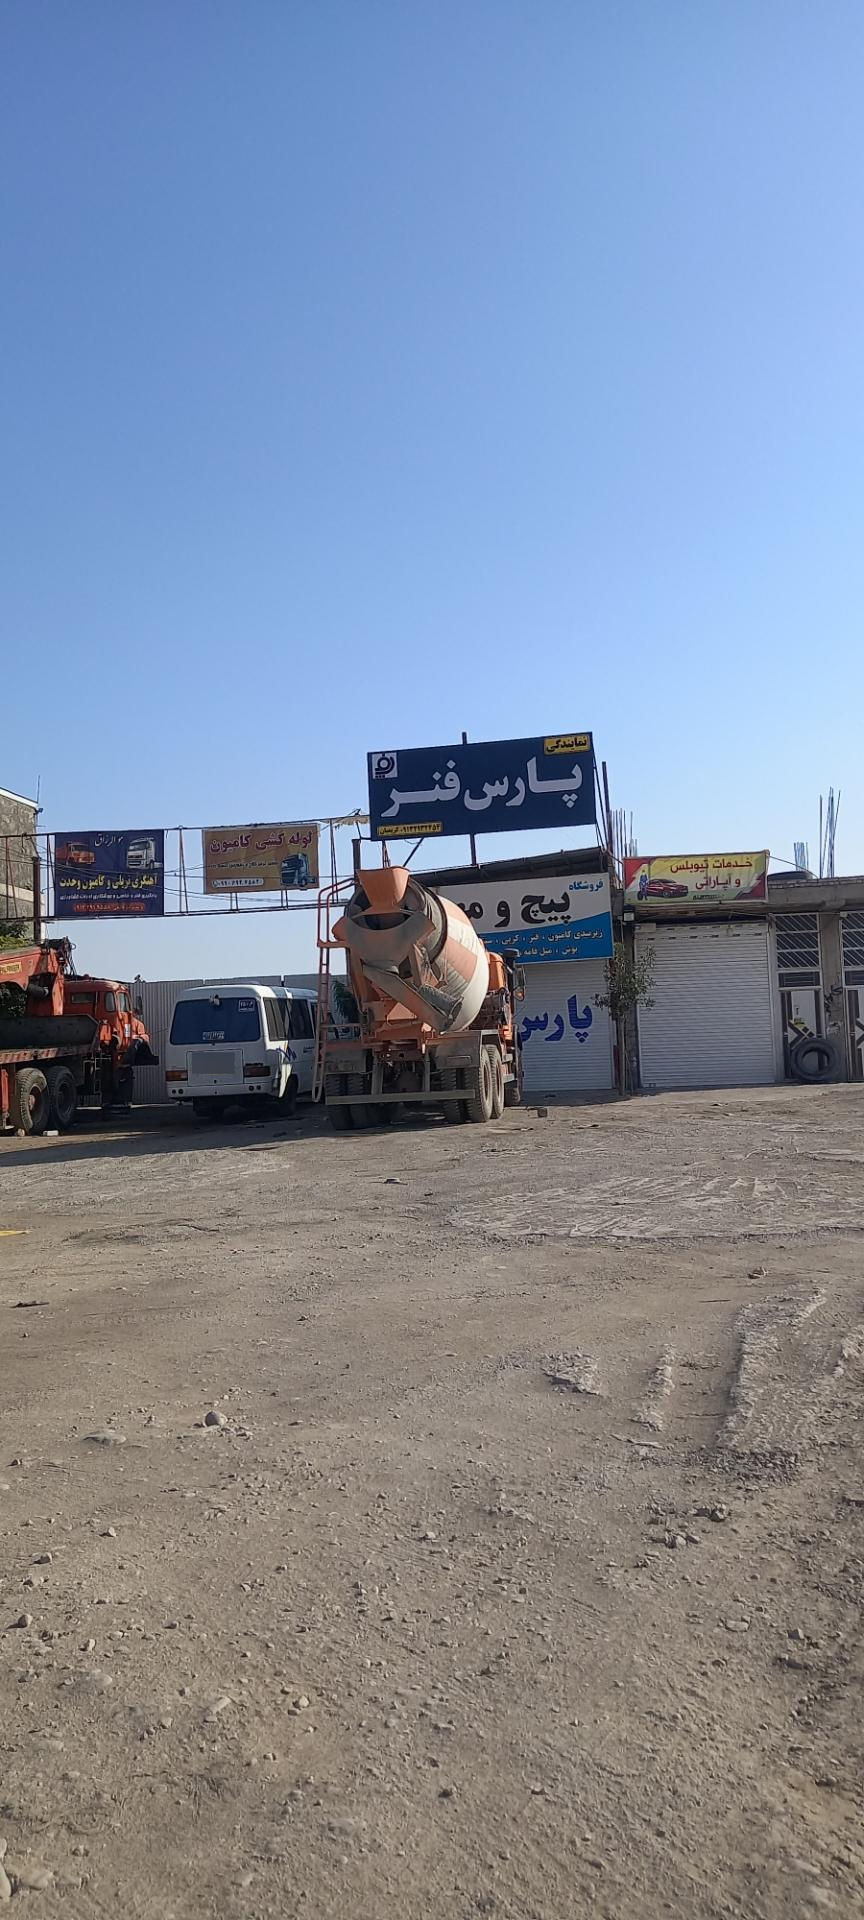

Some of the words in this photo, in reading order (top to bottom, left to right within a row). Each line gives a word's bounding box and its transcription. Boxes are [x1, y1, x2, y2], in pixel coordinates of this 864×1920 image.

[546, 735, 588, 752] نمایندگی
[380, 759, 462, 818] فنر
[463, 757, 583, 810] پارس
[95, 833, 116, 847] الرزاق
[209, 833, 252, 853] کامیون
[256, 832, 285, 850] کشی
[289, 830, 313, 848] لوله
[670, 860, 709, 873] تیوبلس
[712, 858, 753, 869] خدمات
[60, 877, 81, 889] وحدت
[82, 874, 105, 889] کامیون
[106, 879, 111, 889] و
[568, 878, 604, 892] فروشگاه
[695, 875, 732, 890] آپاراتی
[735, 879, 741, 887] و
[496, 901, 511, 927] و
[520, 890, 572, 926] پیچ
[529, 933, 540, 944] فنر
[547, 929, 572, 943] کامیون
[521, 994, 593, 1044] پارس
